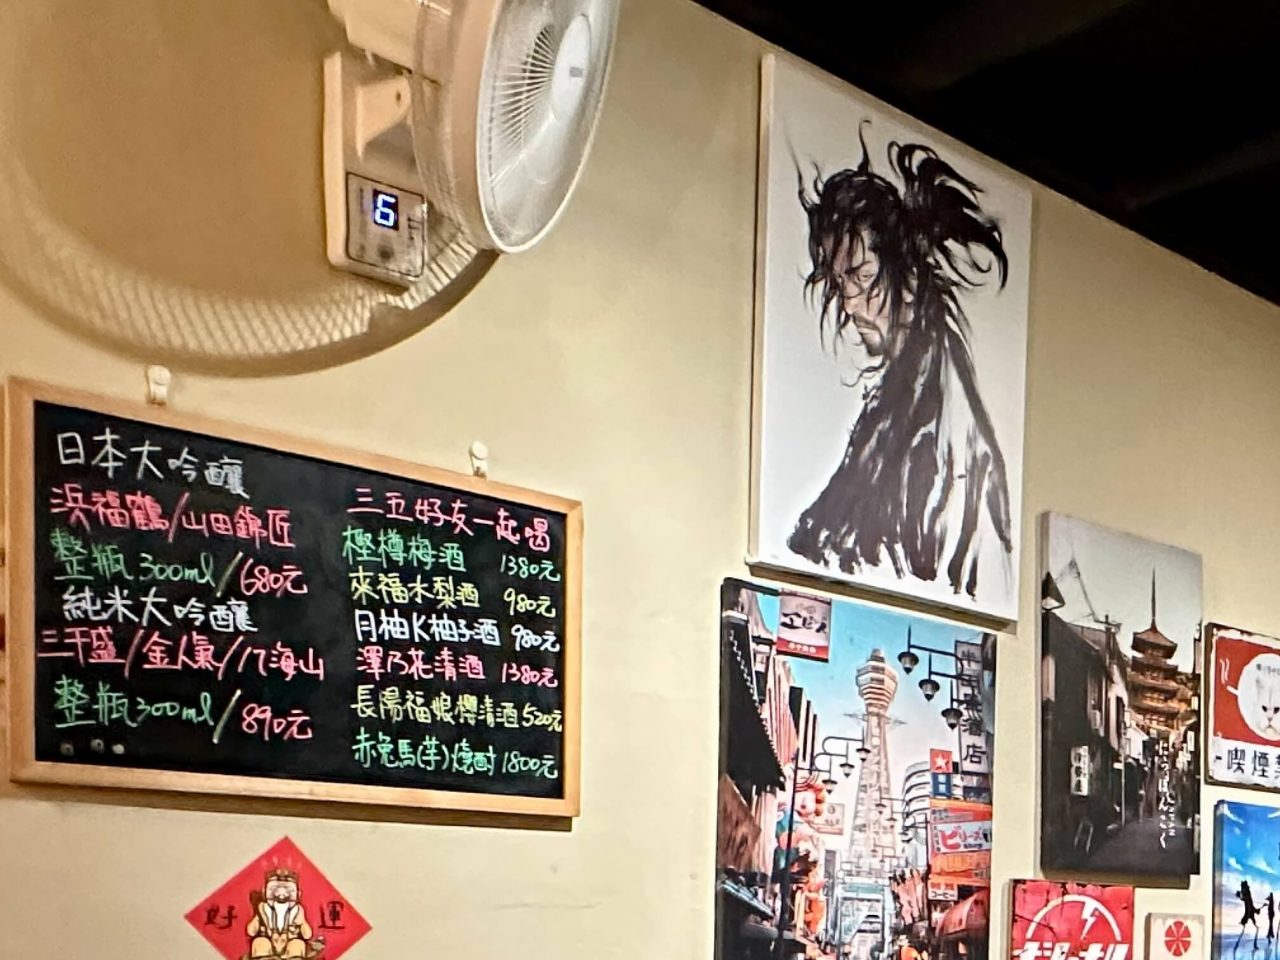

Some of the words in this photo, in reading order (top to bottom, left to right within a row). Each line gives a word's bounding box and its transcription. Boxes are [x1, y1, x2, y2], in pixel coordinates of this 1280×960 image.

[375, 194, 396, 226] 6
[500, 554, 561, 582] 1380元
[503, 588, 556, 618] 980元
[511, 624, 560, 652] 980元
[501, 662, 558, 688] 1380元
[522, 702, 562, 732] 520元
[502, 751, 558, 779] 1800元
